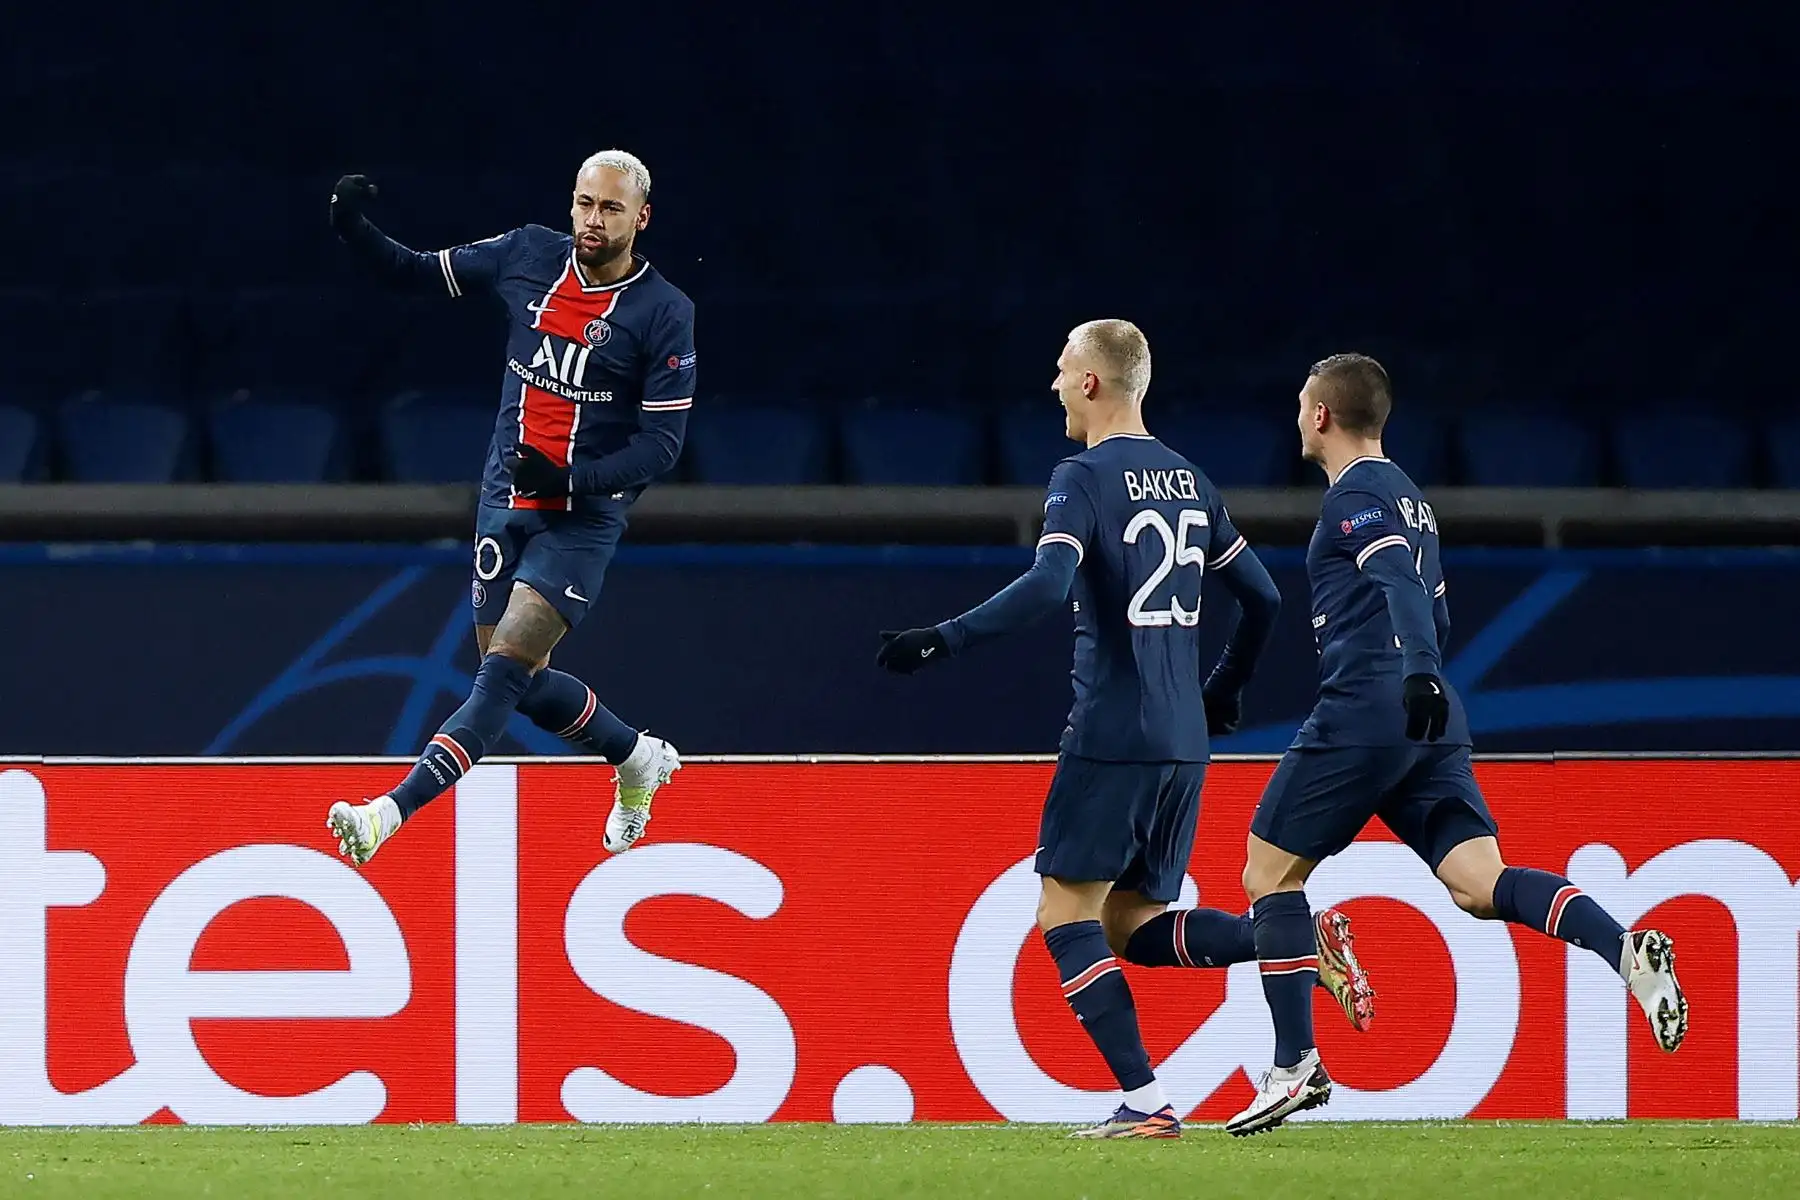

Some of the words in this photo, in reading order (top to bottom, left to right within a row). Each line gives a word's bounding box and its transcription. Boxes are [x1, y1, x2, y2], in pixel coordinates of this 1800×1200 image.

[535, 375, 559, 393] LIVE
[560, 385, 613, 402] LIMITLESS
[1124, 469, 1200, 501] BAKKER
[1350, 510, 1383, 527] RESPECT
[1123, 509, 1209, 626] 25
[422, 758, 446, 785] PARIS
